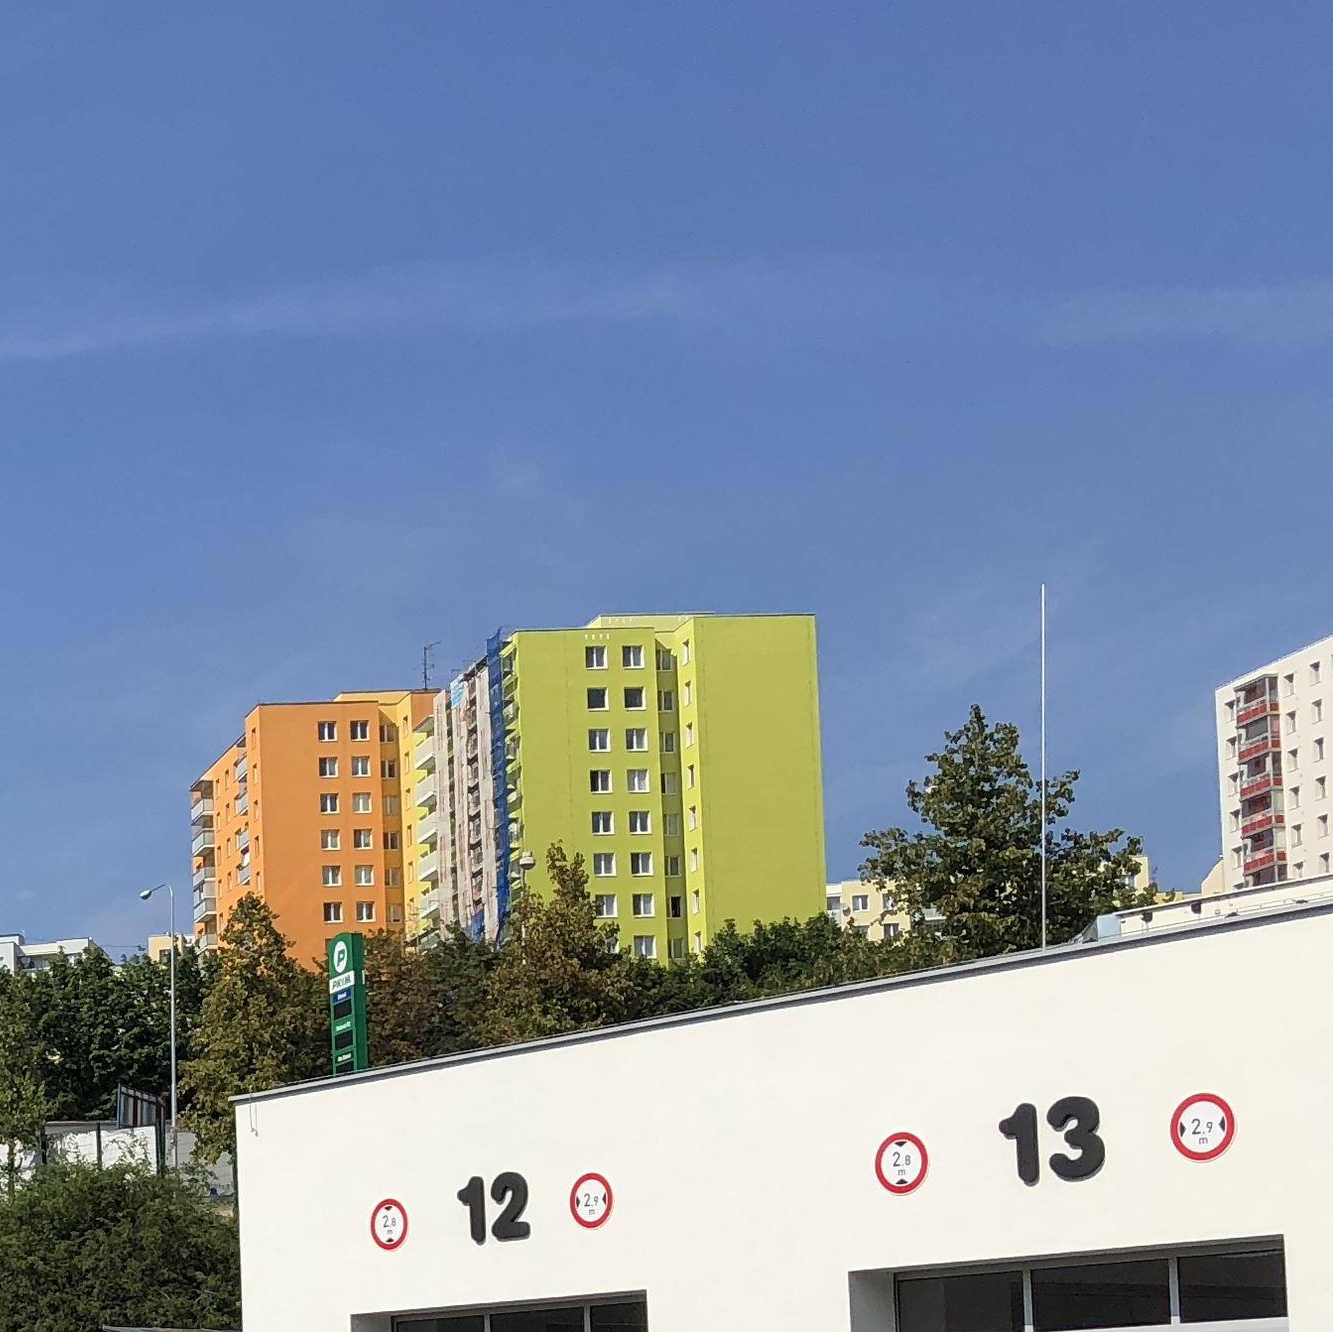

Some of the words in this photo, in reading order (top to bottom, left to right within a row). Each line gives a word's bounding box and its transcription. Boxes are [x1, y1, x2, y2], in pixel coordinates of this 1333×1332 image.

[999, 1096, 1105, 1187] 13
[1198, 1137, 1209, 1145] m
[457, 1172, 531, 1245] 12
